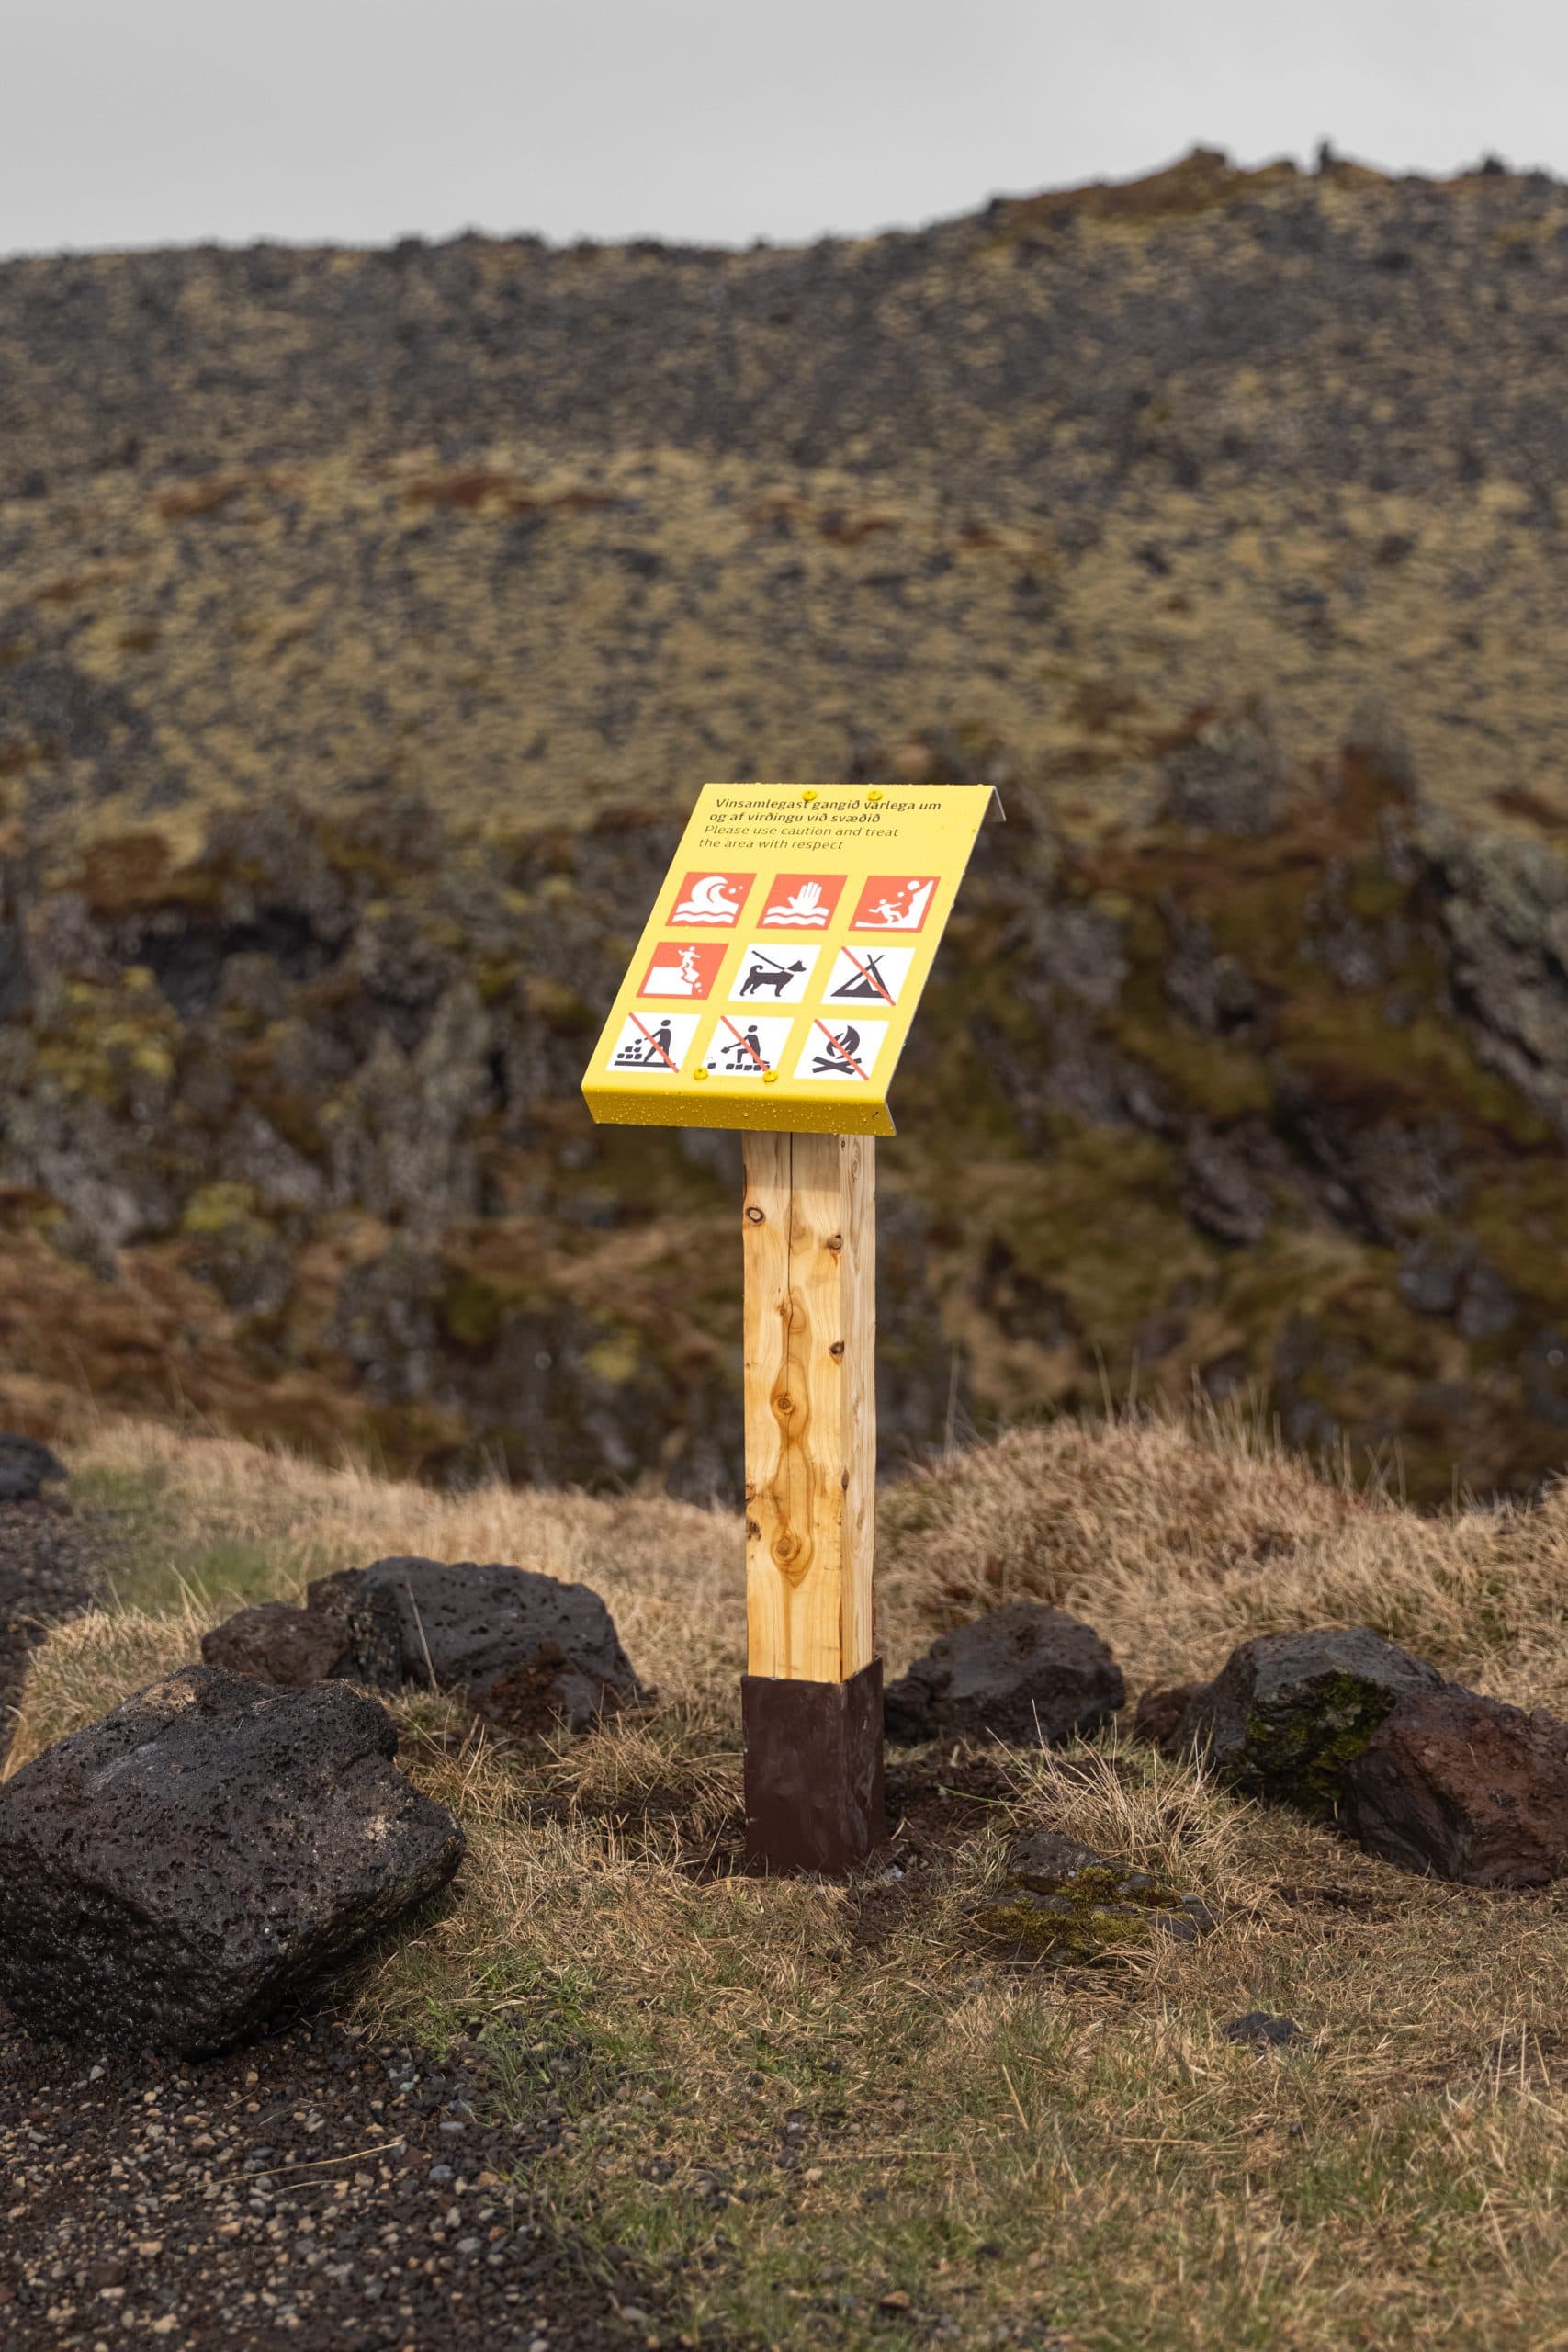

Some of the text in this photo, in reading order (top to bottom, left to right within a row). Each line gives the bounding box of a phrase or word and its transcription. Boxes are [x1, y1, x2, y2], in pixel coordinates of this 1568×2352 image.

[716, 798, 809, 810] Vinsamlegast
[811, 800, 861, 811] gangið
[864, 801, 916, 812] varlega
[709, 812, 881, 824] og af virðingu við svæðið
[705, 825, 750, 835] Please
[781, 827, 831, 836] caution
[835, 828, 863, 837] and
[865, 829, 899, 837] treat
[699, 839, 721, 848] the
[759, 840, 788, 849] with
[792, 842, 843, 852] respect
